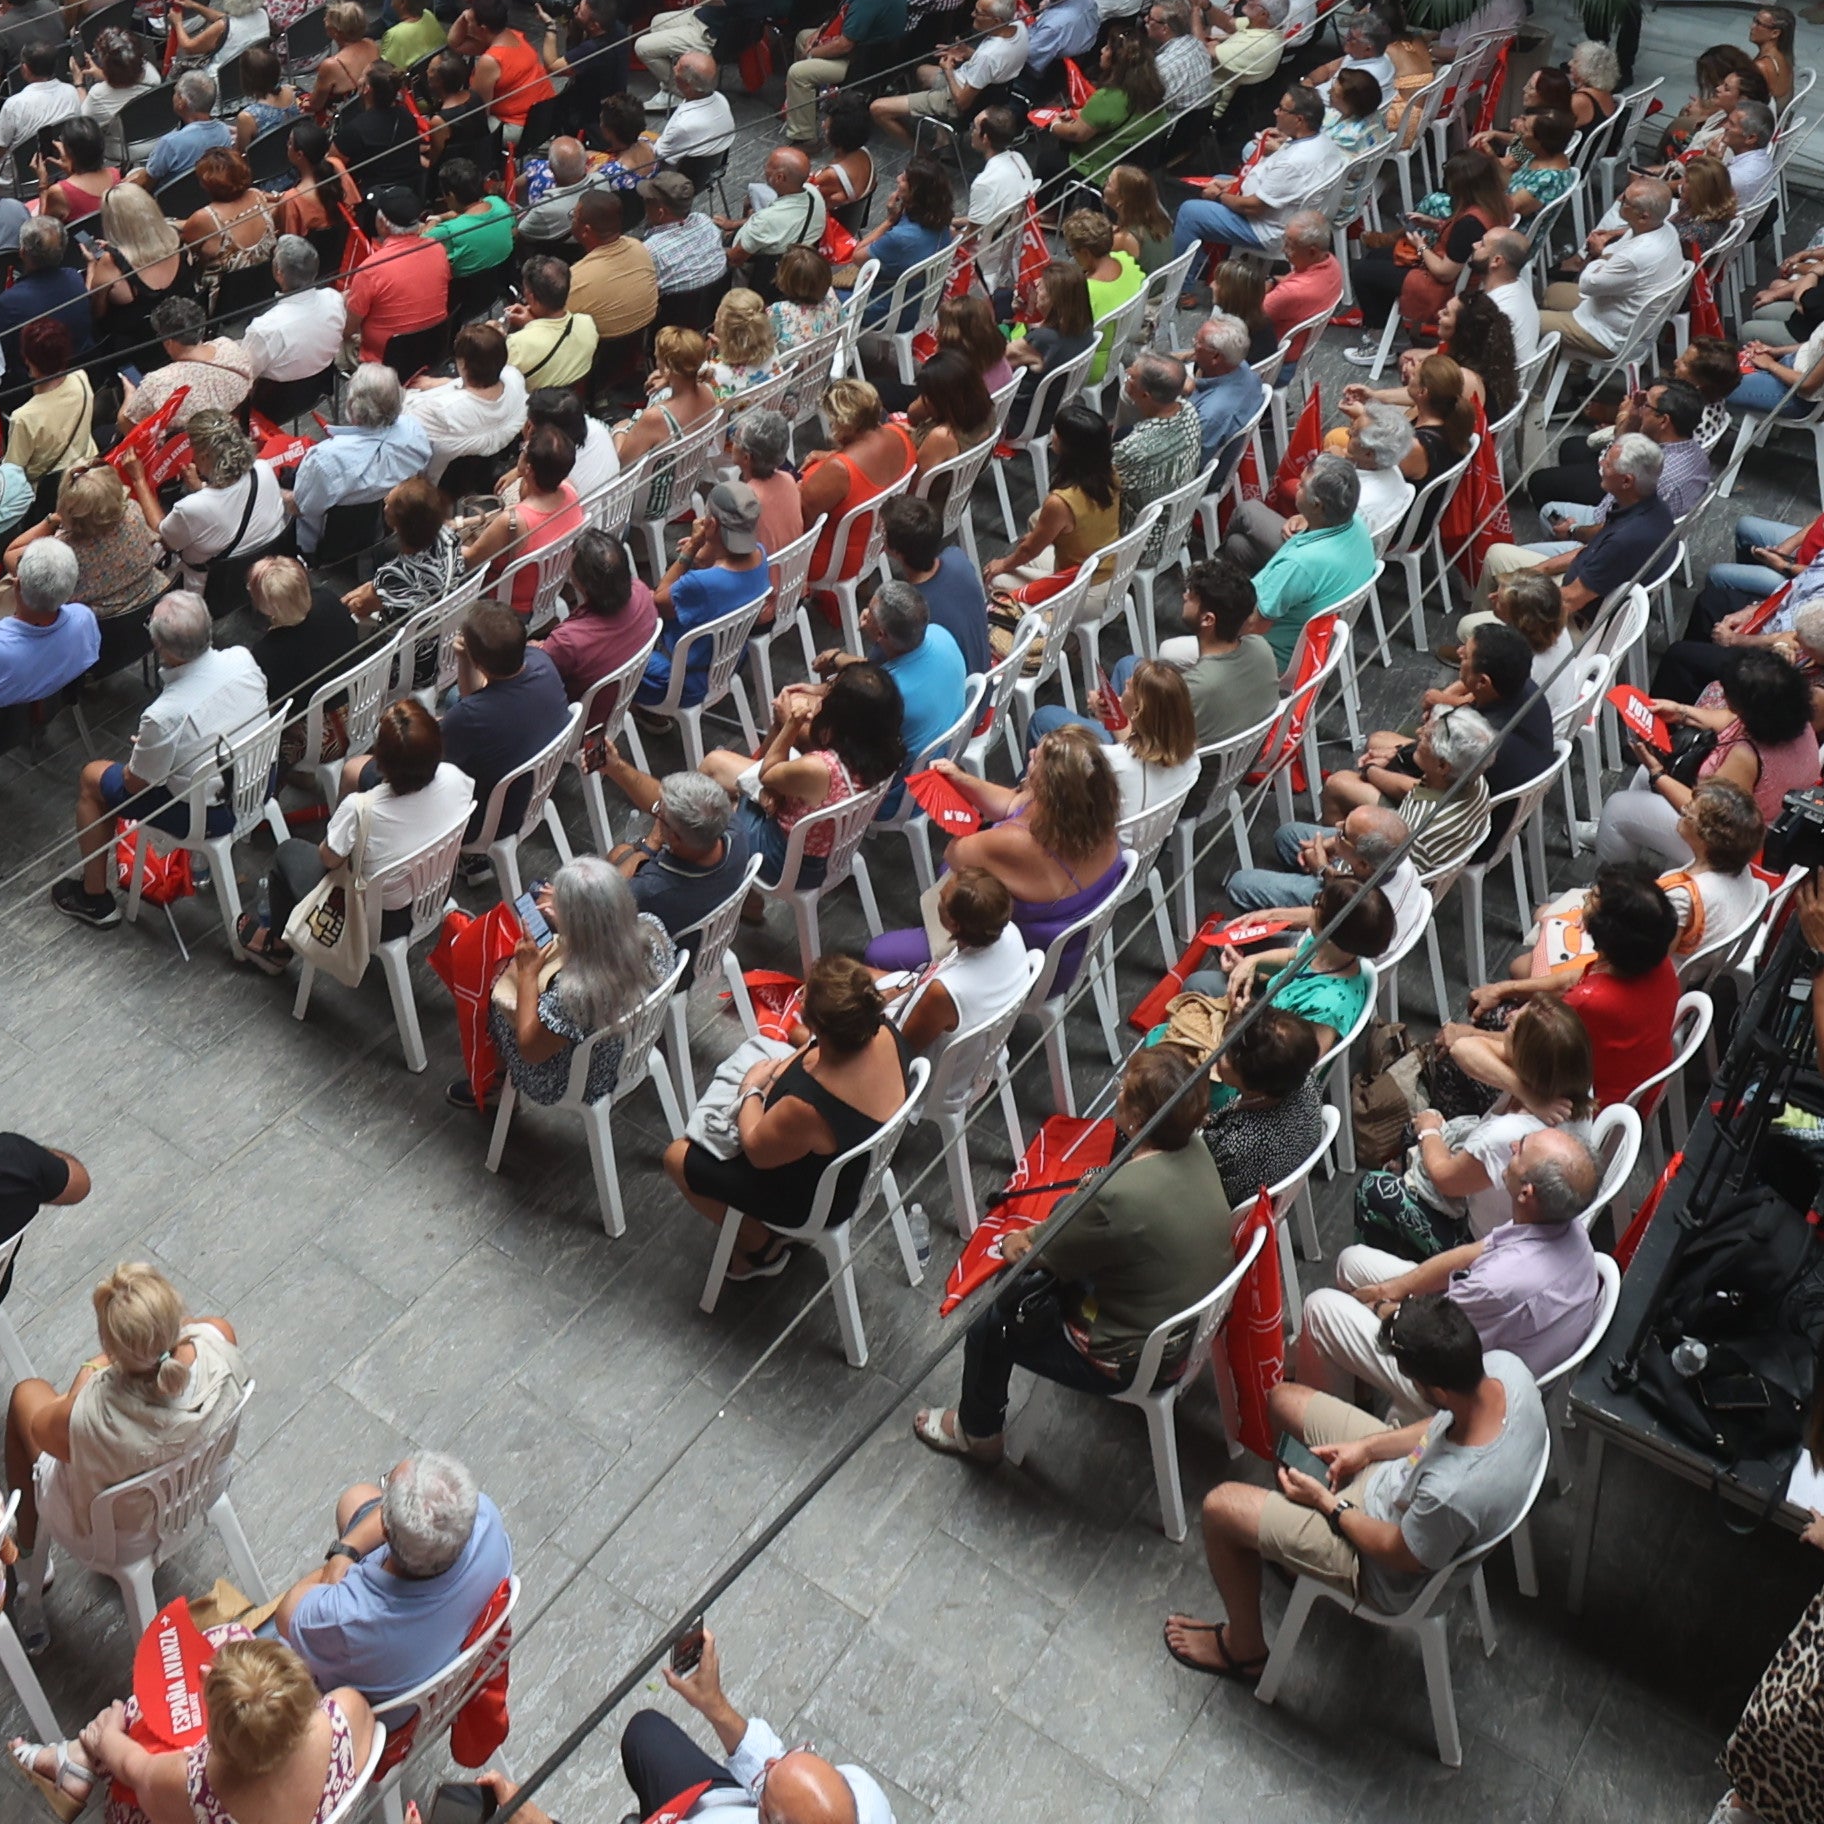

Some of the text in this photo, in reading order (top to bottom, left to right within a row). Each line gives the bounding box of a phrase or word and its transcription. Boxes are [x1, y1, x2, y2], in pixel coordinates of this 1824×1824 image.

[1627, 694, 1654, 730] VOTA
[159, 1626, 191, 1735] ESPAÑA AVANZA
